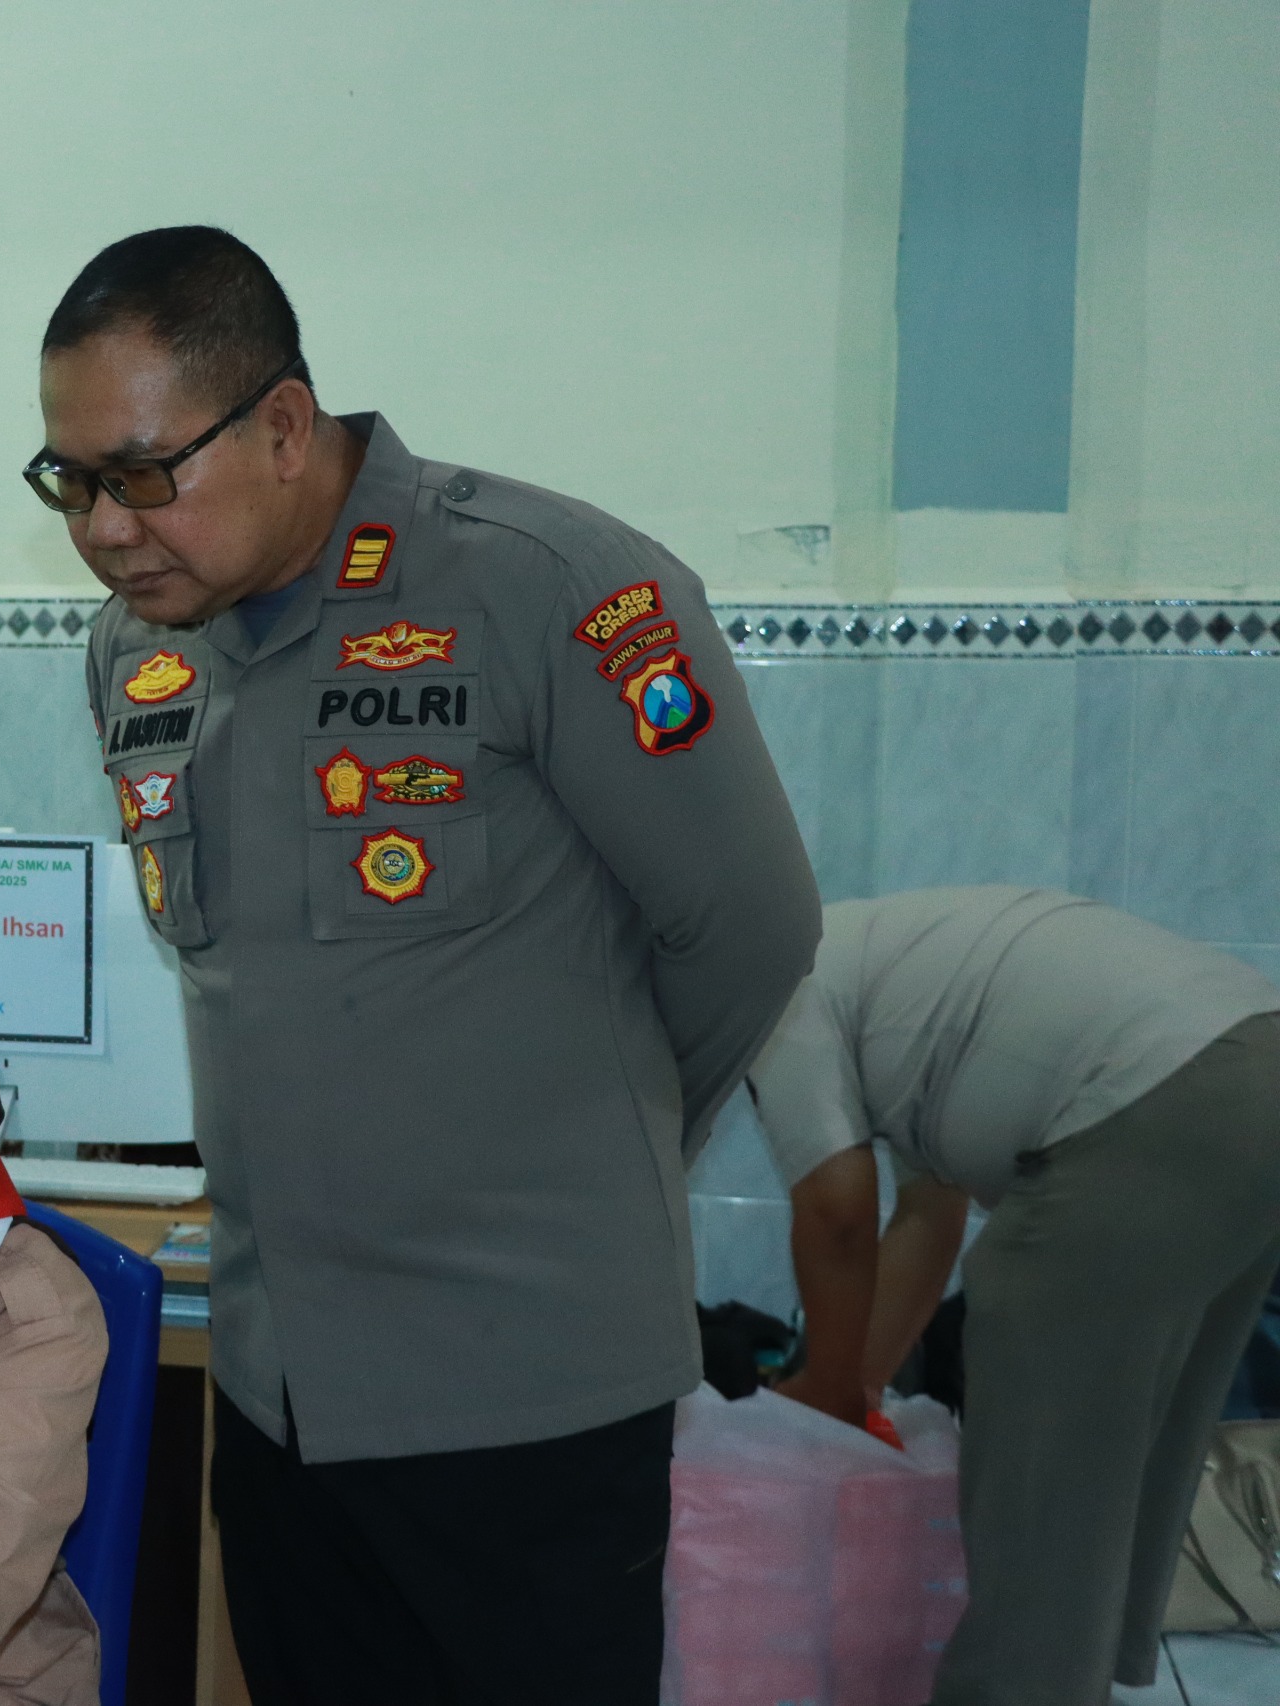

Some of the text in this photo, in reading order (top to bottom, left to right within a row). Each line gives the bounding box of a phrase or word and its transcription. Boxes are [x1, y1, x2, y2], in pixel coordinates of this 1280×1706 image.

[584, 586, 654, 640] POLRES
[600, 601, 654, 640] GRESIK
[608, 626, 673, 674] JAWA TIMUR
[318, 685, 467, 728] POLRI
[16, 859, 49, 872] SMK/
[51, 861, 73, 872] MA
[2, 916, 64, 938] Ihsan
